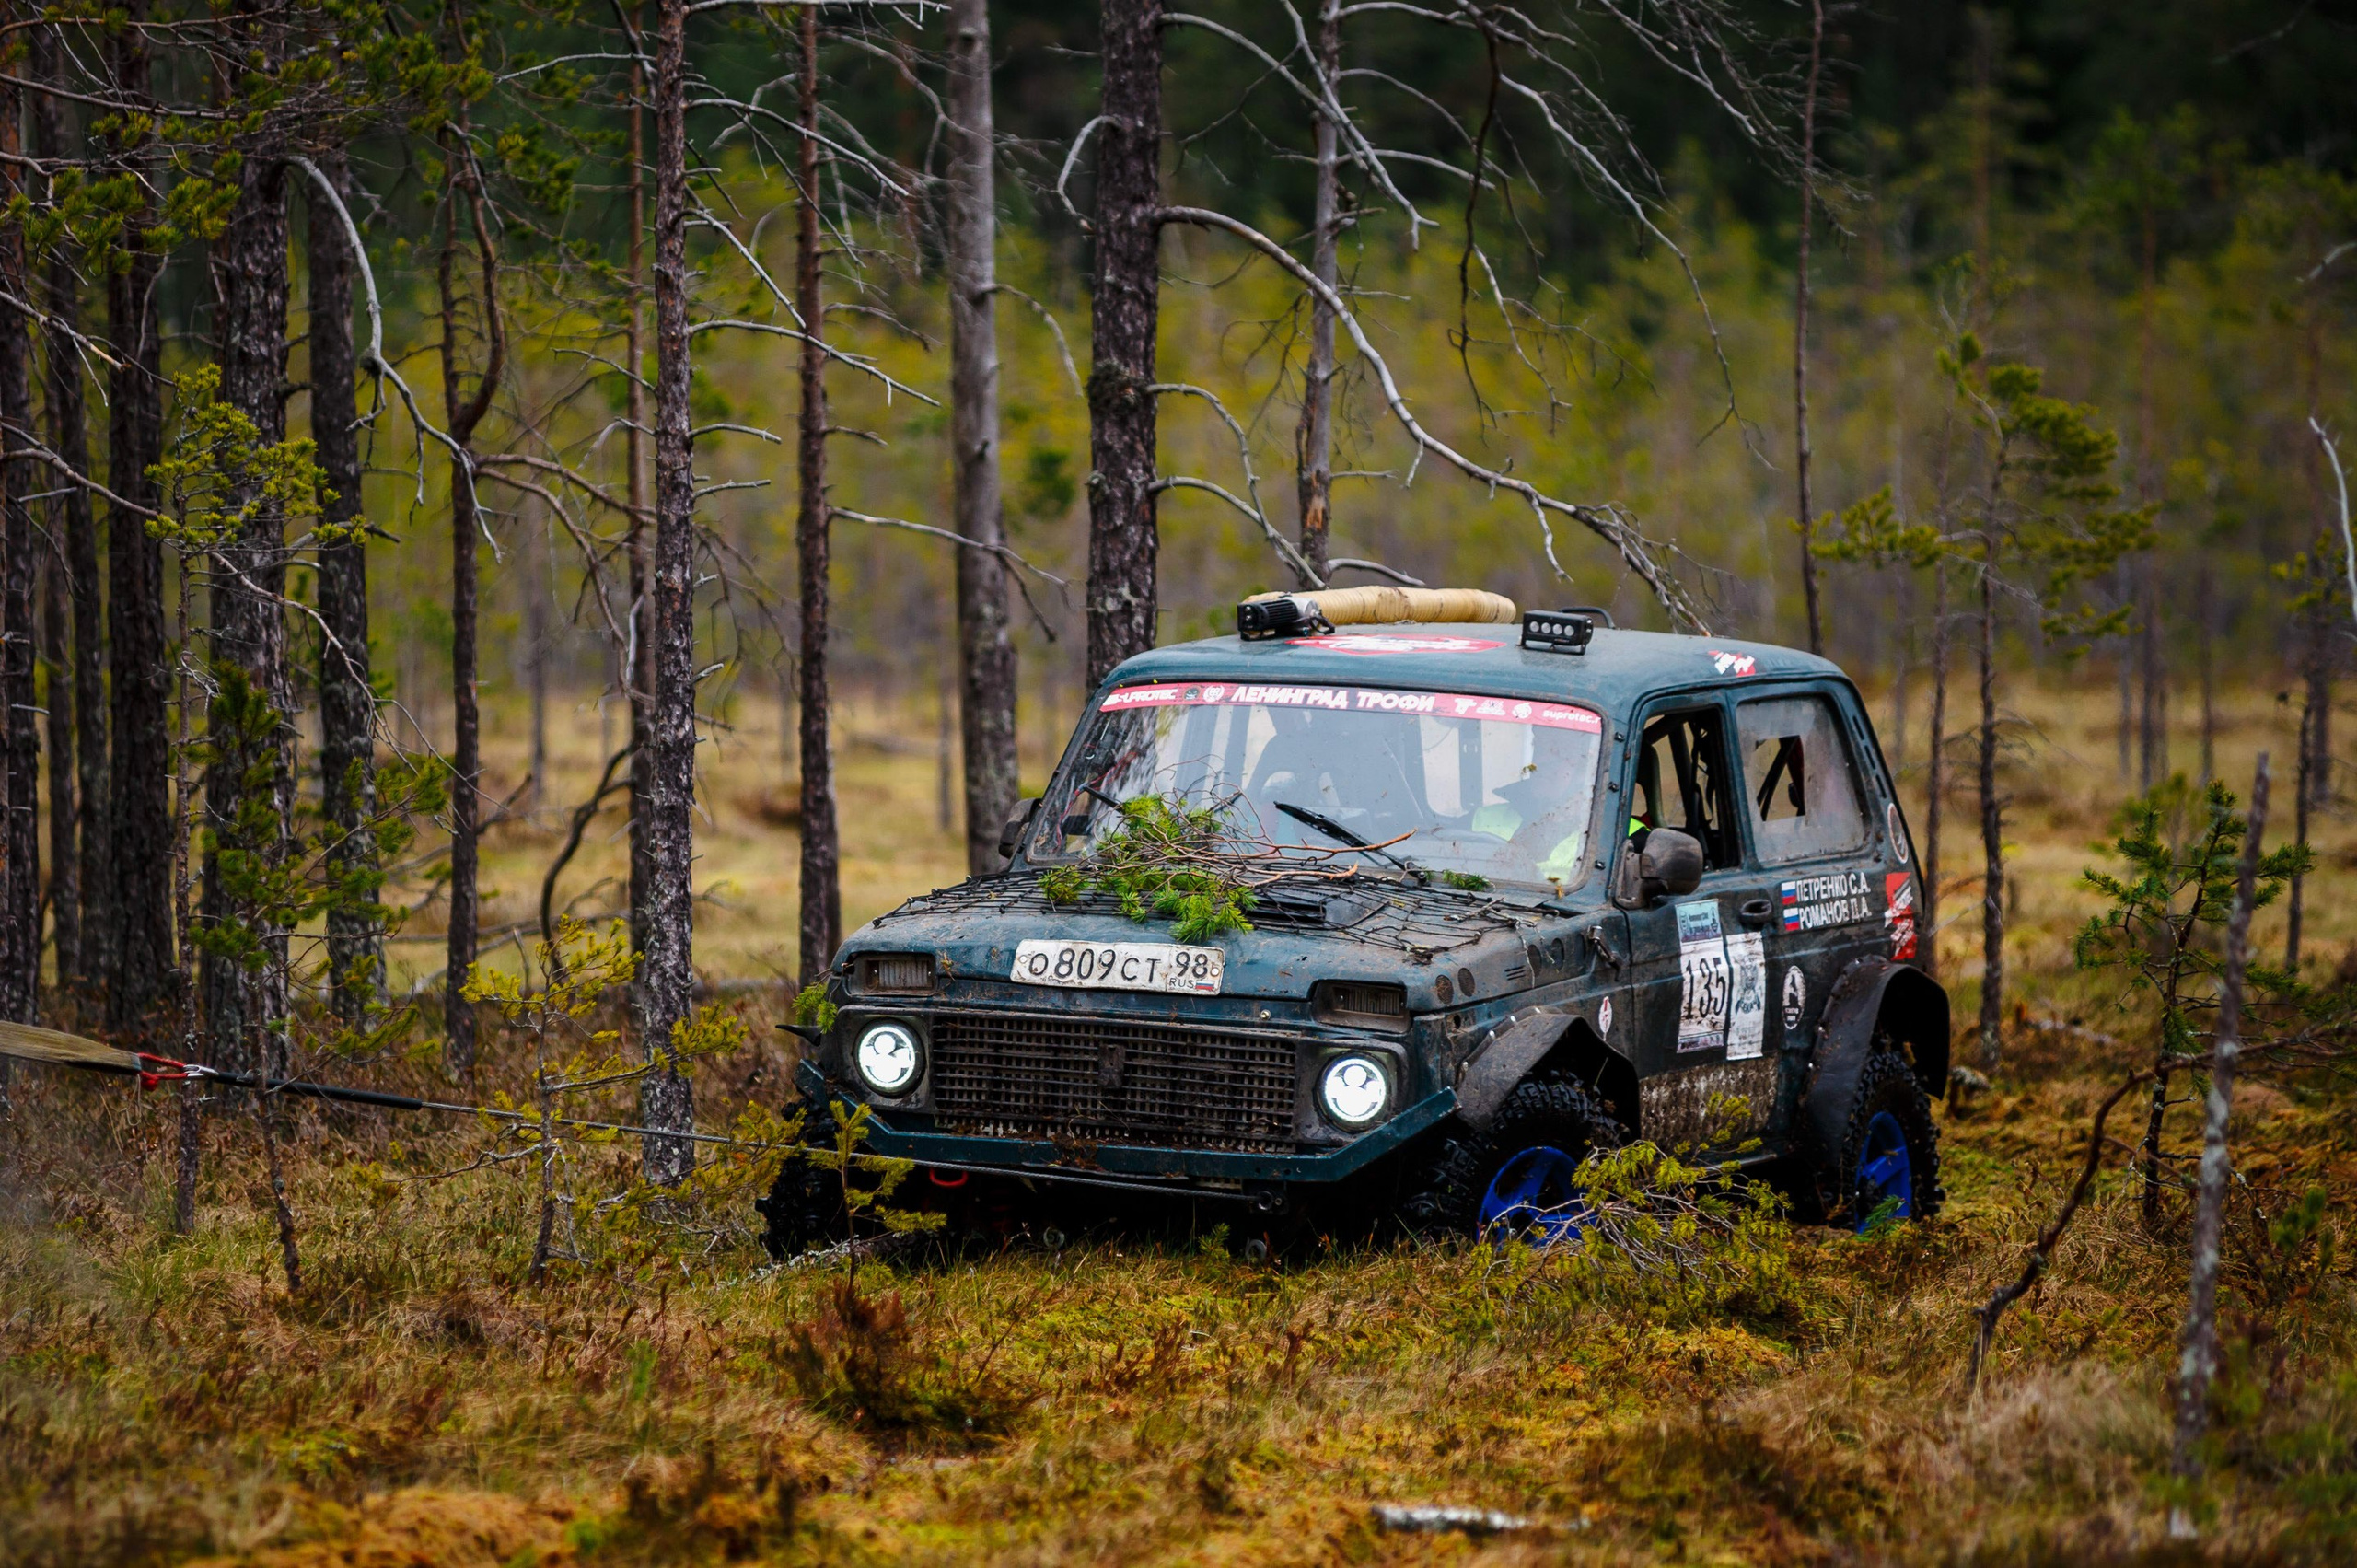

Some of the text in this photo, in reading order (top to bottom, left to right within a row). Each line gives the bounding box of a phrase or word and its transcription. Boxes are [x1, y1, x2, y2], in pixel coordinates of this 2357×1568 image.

[1230, 686, 1436, 713] ЛЕНИНГРАД ТРОФИ
[1796, 874, 1848, 902] ПЕТРЕНКО
[1799, 899, 1850, 930] РОМАНОВ
[1175, 951, 1209, 979] 98
[1168, 977, 1194, 989] RUS
[1685, 958, 1726, 1020] 135
